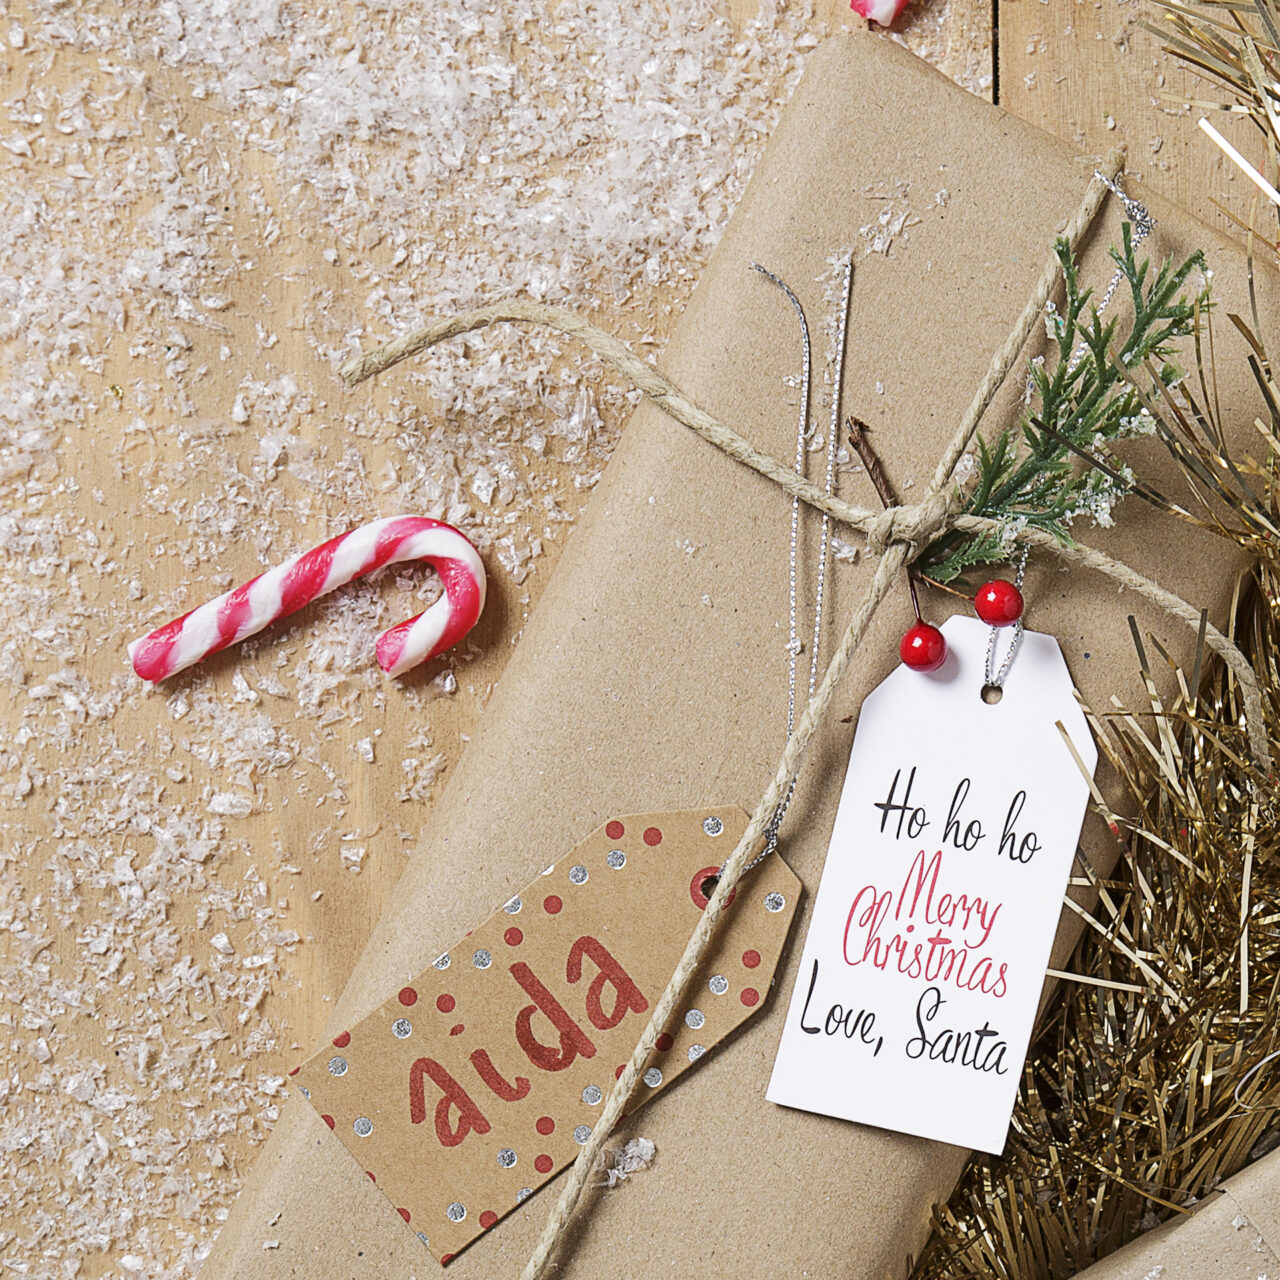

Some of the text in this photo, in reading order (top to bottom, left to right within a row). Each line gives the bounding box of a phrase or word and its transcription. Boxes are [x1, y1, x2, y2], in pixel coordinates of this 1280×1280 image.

[874, 766, 1042, 864] Ho ho ho
[843, 885, 1009, 998] Christmas
[896, 849, 1003, 949] Merry
[800, 959, 1009, 1075] Love, Santa
